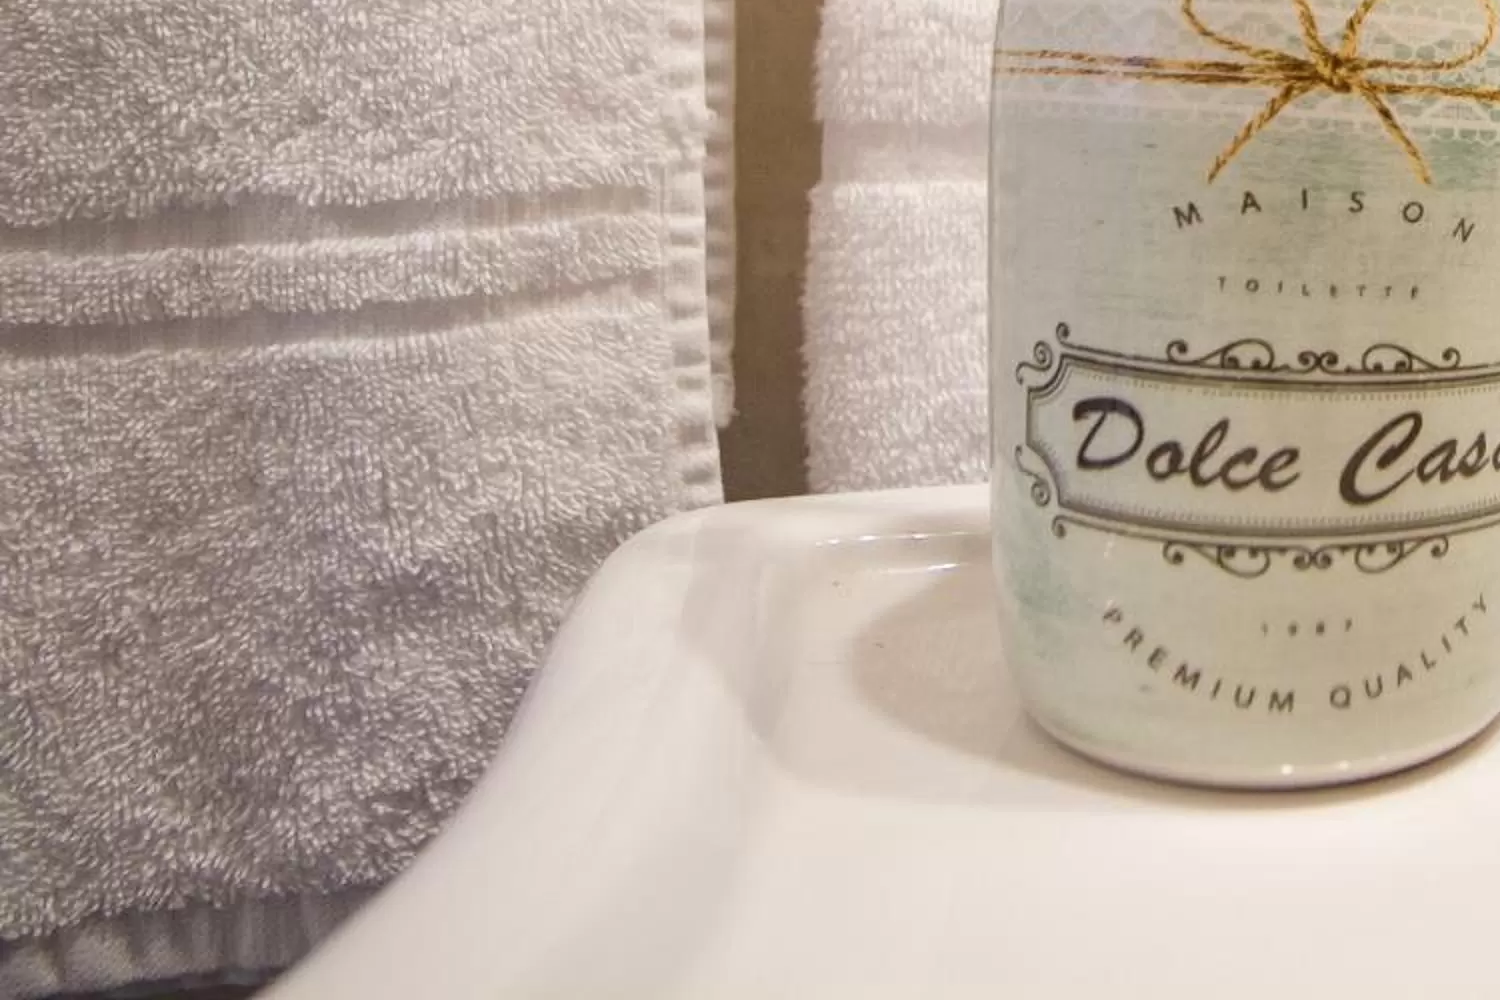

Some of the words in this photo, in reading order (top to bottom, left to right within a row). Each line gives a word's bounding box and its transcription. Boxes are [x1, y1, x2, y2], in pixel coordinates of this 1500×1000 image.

[1173, 190, 1474, 244] MAISON
[1072, 396, 1300, 492] Dolce
[1103, 606, 1294, 713] PREMIUM
[1329, 594, 1487, 710] QUALITY
